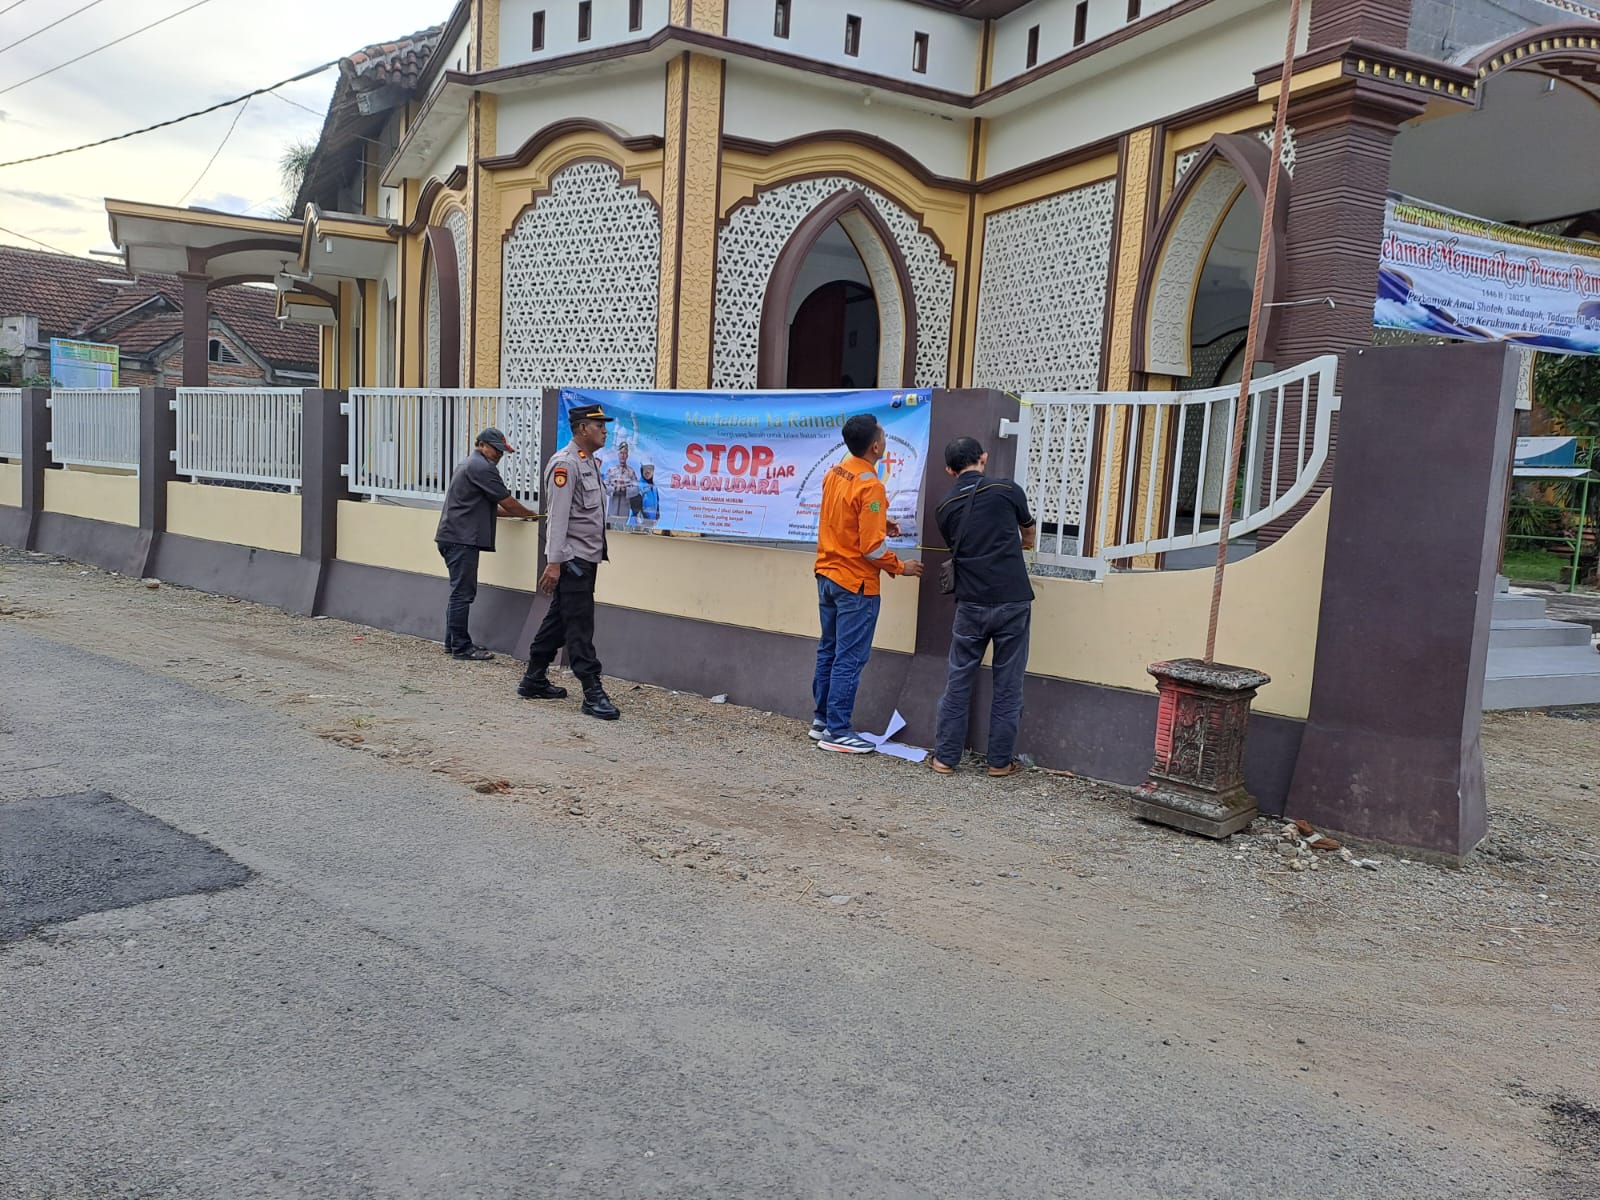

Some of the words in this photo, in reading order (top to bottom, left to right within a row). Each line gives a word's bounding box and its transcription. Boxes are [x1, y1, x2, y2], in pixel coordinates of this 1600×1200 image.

[1381, 232, 1434, 267] elamat
[1436, 238, 1526, 286] Menunaikan
[1528, 259, 1569, 288] Puasa
[1408, 291, 1452, 308] Perbanyak
[1453, 300, 1475, 311] Amal
[1456, 313, 1474, 326] Jaga
[1476, 316, 1520, 331] Kerukunan
[1521, 322, 1527, 332] &
[1529, 322, 1571, 337] Kedamaian
[684, 411, 758, 428] Marhaban
[684, 443, 774, 476] STOP
[766, 465, 795, 479] LIAR
[670, 473, 722, 491] BALON
[724, 478, 780, 495] UDARA
